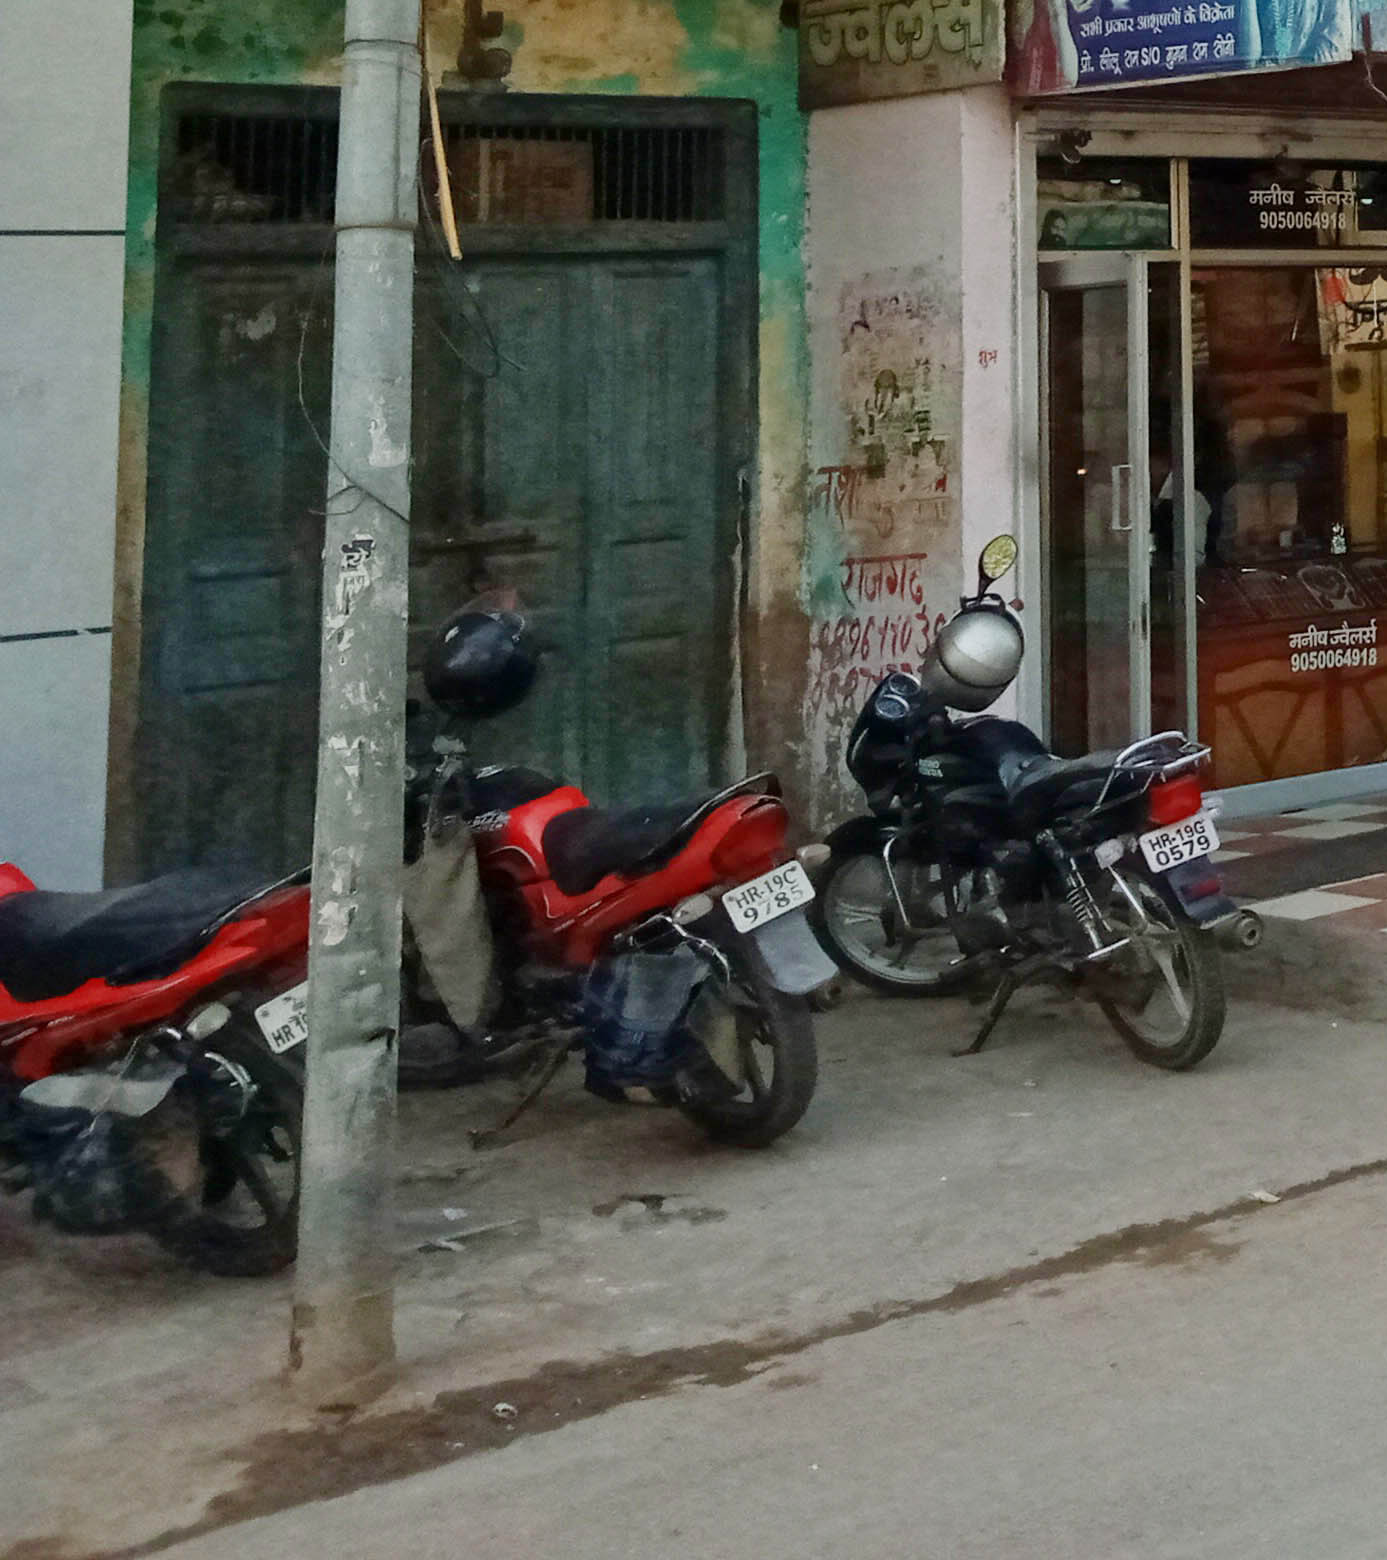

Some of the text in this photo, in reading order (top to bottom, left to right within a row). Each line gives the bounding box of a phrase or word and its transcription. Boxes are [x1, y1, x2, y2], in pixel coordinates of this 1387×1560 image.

[1080, 16, 1102, 38] सभी
[1104, 18, 1134, 37] प्रकार
[1184, 5, 1197, 24] के
[1199, 2, 1235, 24] विक्रेता
[1124, 50, 1139, 69] राम
[1141, 47, 1160, 67] S/O
[1192, 42, 1208, 61] राम
[1248, 183, 1356, 207] मनीष ज्वैलर्स
[1259, 211, 1347, 231] 9050064918
[1288, 618, 1378, 650] मनीष ज्वैलर्स
[1290, 645, 1378, 673] 9050064918
[1148, 820, 1206, 853] HR-19G
[1154, 836, 1212, 869] 0579
[736, 865, 798, 910] HR-19C
